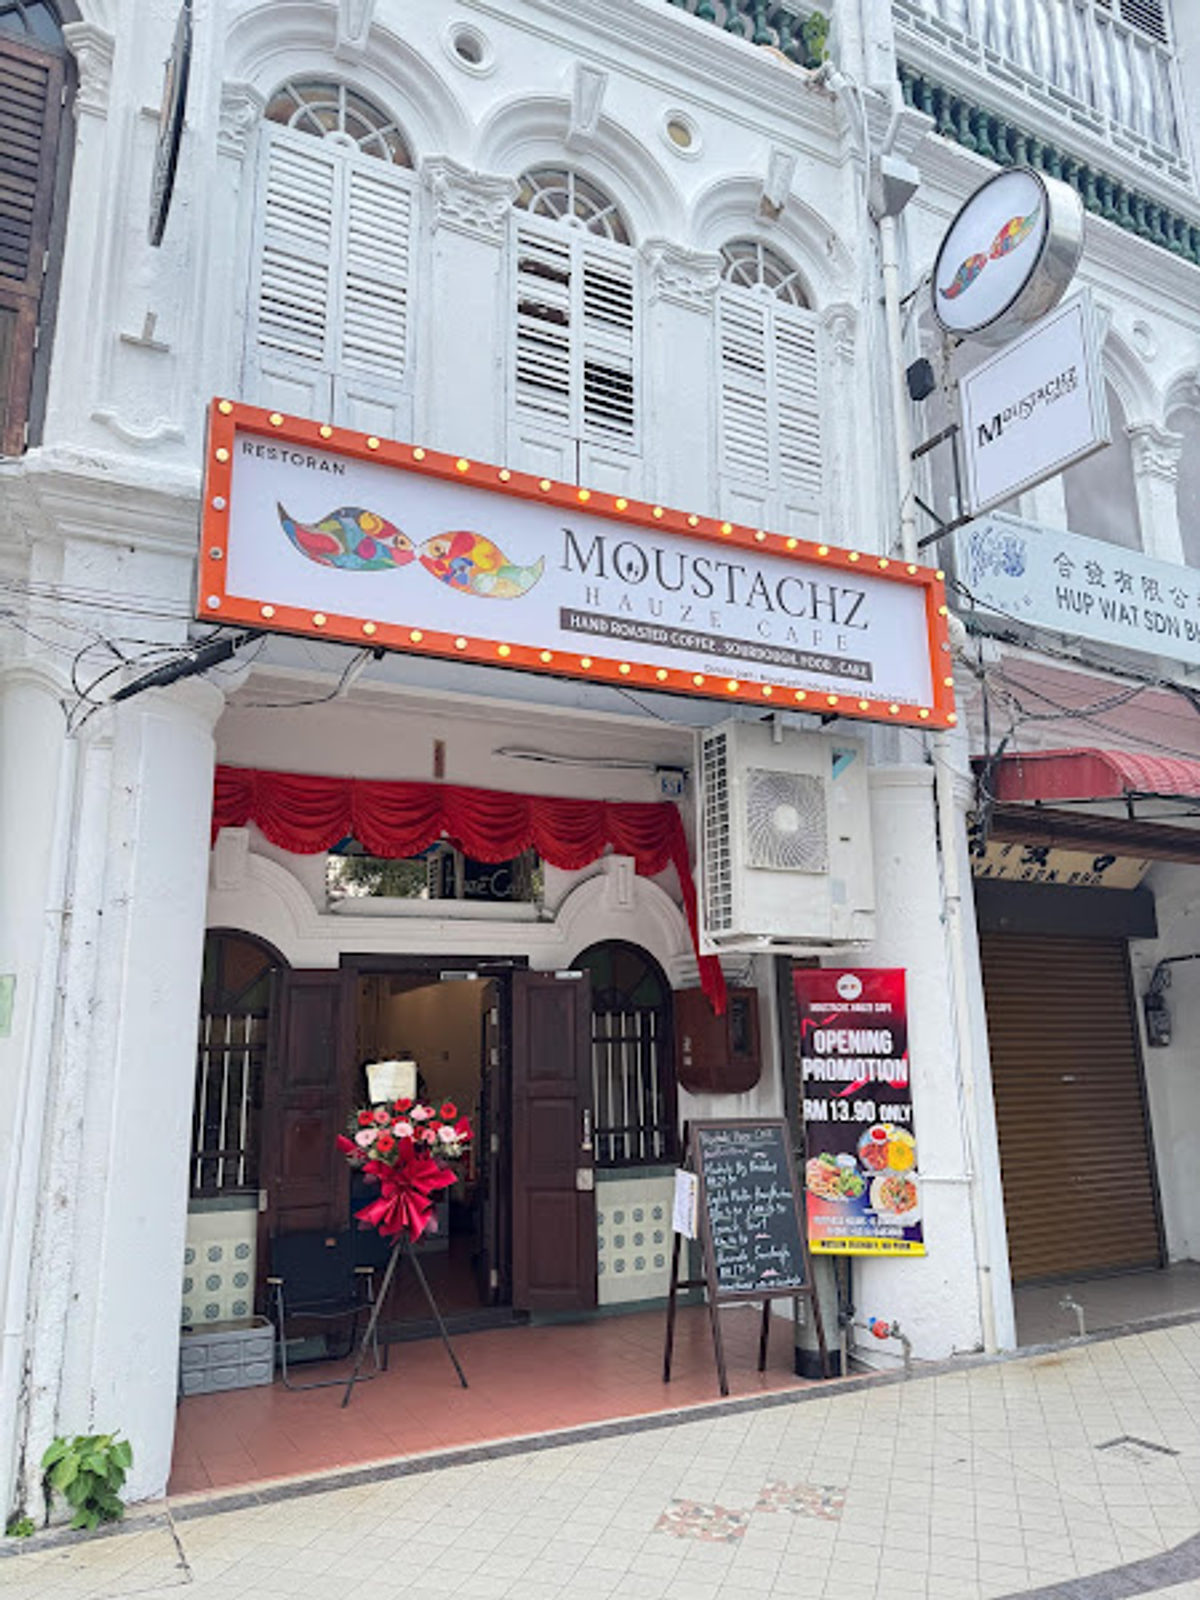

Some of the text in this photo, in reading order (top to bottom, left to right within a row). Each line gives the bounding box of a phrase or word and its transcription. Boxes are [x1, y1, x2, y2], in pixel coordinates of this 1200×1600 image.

[241, 441, 347, 477] RESTORAN
[560, 528, 869, 631] MOUSTACHZ
[1053, 551, 1200, 610] 合發有限公
[585, 584, 850, 652] HAUZE CAFE
[1056, 585, 1094, 616] HUP
[1098, 597, 1139, 628] WAT
[1143, 609, 1180, 639] SDN
[569, 613, 610, 634] HAND
[610, 621, 669, 645] ROASTED
[669, 631, 716, 653] COFFEE
[812, 1029, 893, 1055] OPENING
[802, 1058, 908, 1082] PROMOTION
[803, 1099, 911, 1121] RM 13.90 ONLY
